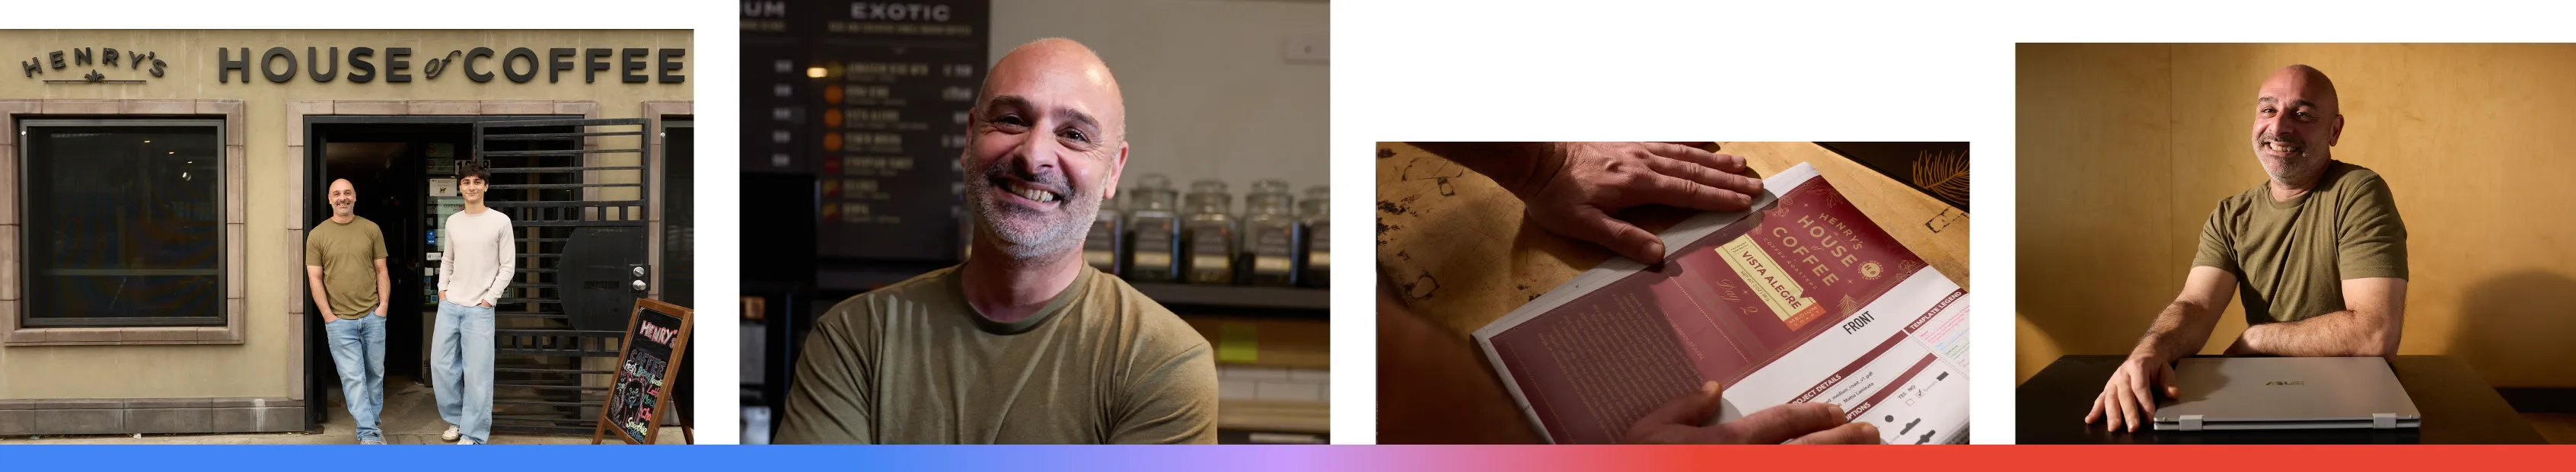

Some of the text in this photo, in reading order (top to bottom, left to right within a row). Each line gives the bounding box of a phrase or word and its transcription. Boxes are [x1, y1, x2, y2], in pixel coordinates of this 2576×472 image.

[850, 2, 952, 21] EXOTIC
[21, 46, 168, 78] HENRY'S
[218, 46, 686, 84] HOUSE of COFFEE
[1797, 215, 1858, 267] HOUSE
[1819, 213, 1863, 250] HENRY'S
[1763, 238, 1818, 290] COFFEE ROASTERS
[1772, 227, 1840, 286] COFFEE
[1740, 270, 1749, 279] NET
[1742, 250, 1802, 309] VISTA ALEGRE
[1716, 279, 1758, 314] Day 2
[1909, 307, 1940, 330] TEMPLATE
[1938, 291, 1962, 308] LEGEND
[1789, 306, 1818, 324] MEDIUM
[1842, 311, 1875, 335] FRONT
[630, 349, 667, 379] COFFEE
[1792, 374, 1841, 405] ROJECT DETAILS
[1843, 382, 1875, 403] Matte Laminate
[1897, 391, 1907, 400] YES
